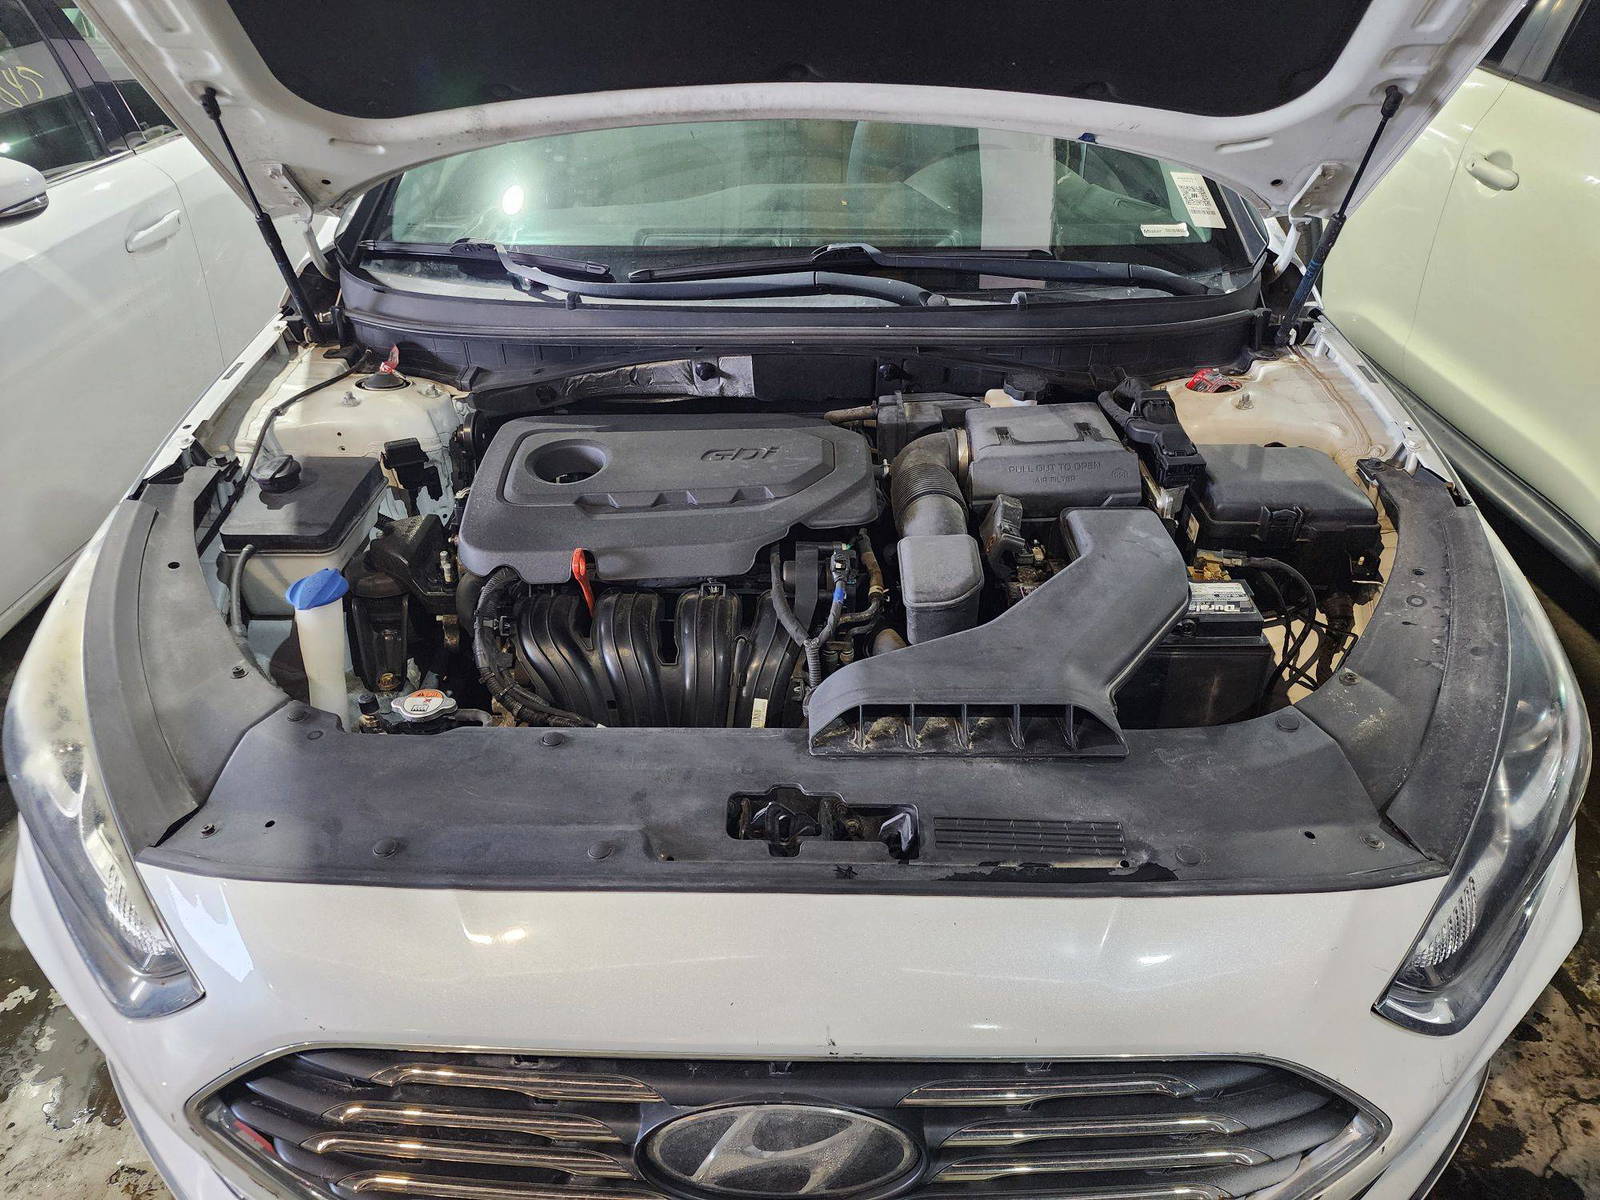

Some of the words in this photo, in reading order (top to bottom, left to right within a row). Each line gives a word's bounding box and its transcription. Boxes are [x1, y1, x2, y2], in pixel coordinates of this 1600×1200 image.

[1008, 464, 1034, 474] PULL
[1035, 463, 1057, 473] OUT
[1059, 462, 1072, 472] TO
[1074, 460, 1101, 471] OPEN
[1034, 476, 1047, 484] AIR
